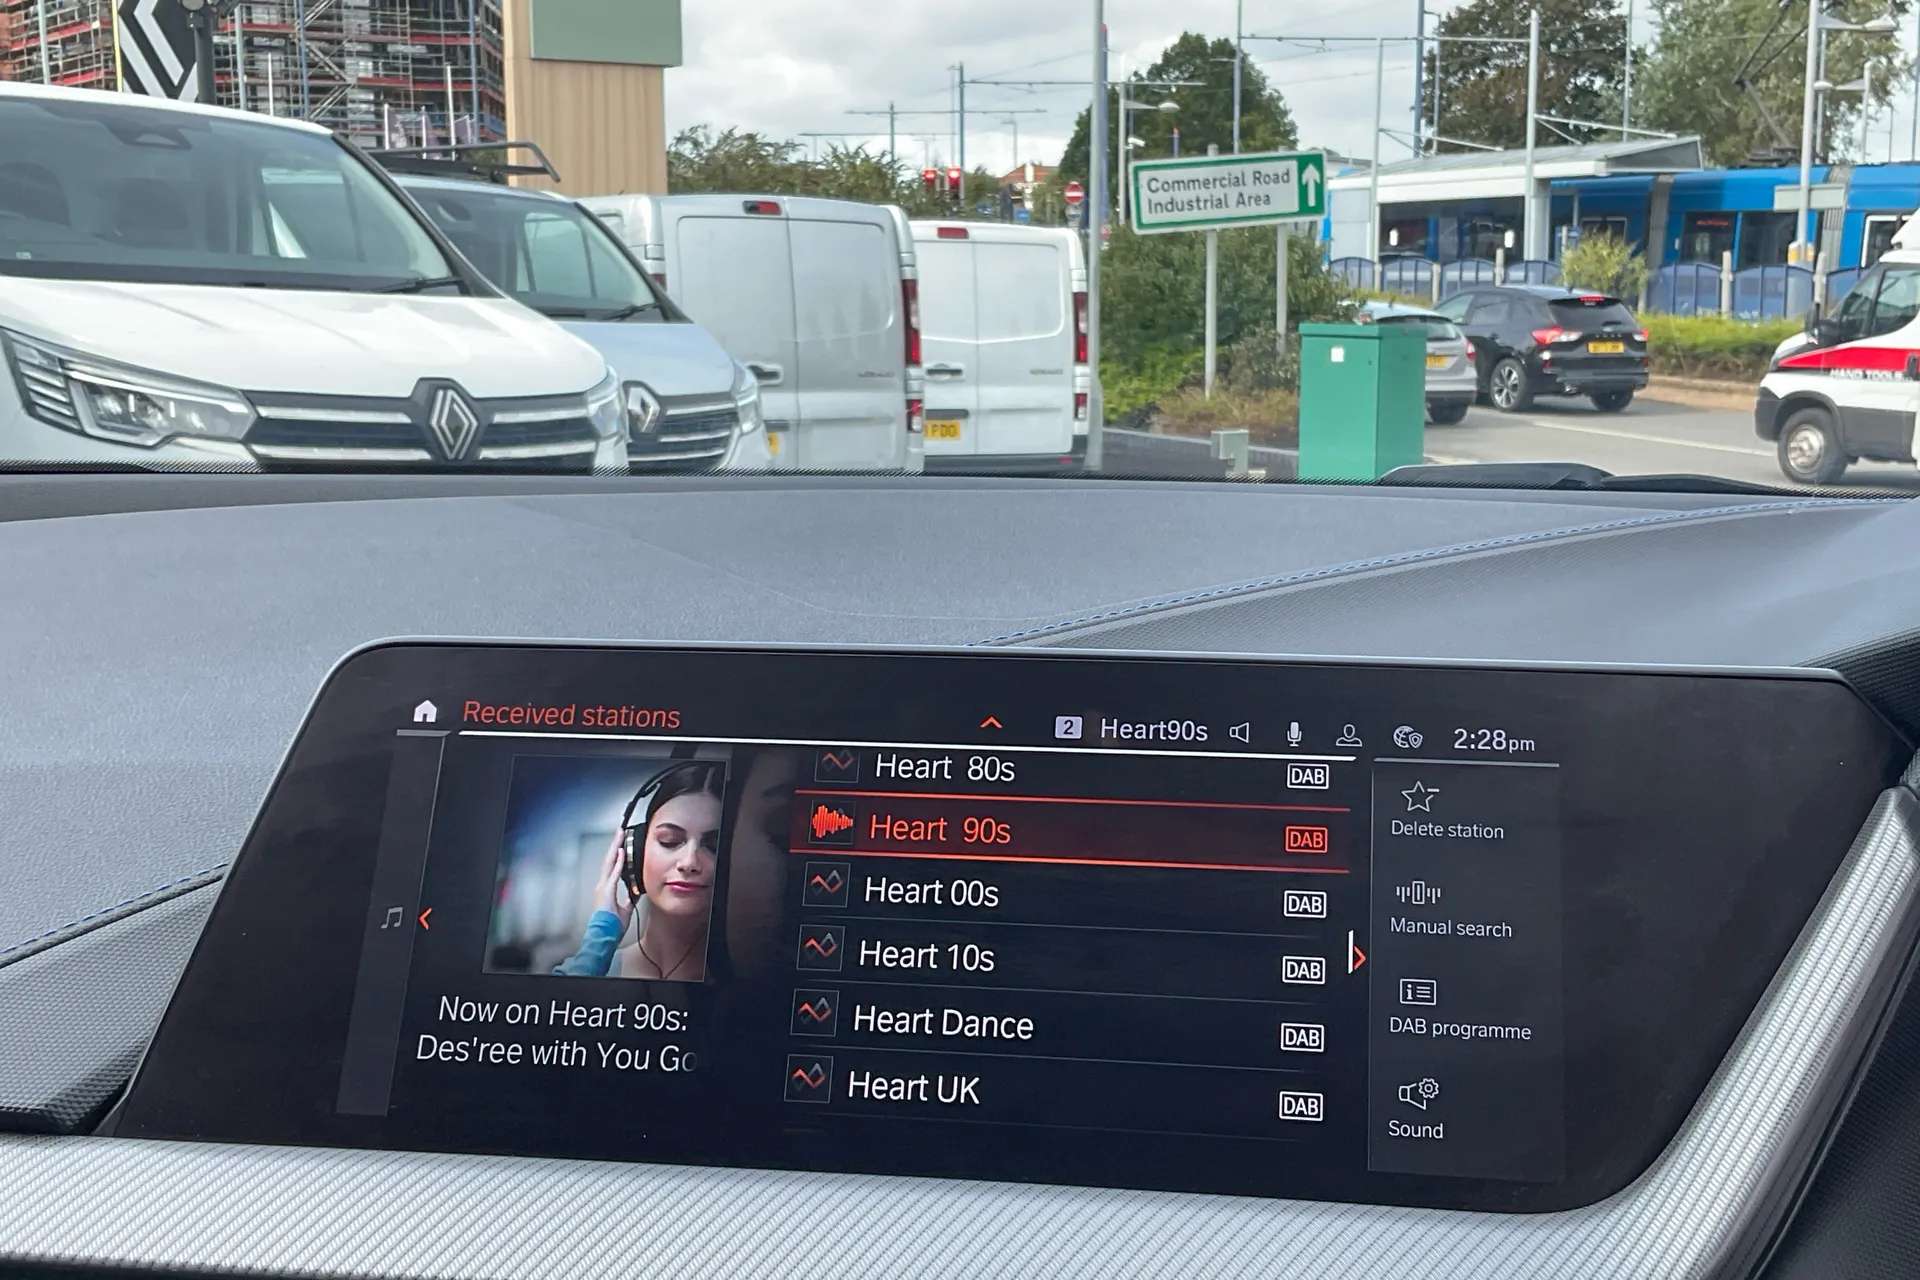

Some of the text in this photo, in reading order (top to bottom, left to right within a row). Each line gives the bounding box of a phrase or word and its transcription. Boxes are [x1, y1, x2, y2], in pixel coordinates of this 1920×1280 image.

[1146, 168, 1291, 194] Commercial Road
[1147, 192, 1272, 215] Industrial Area
[462, 700, 681, 729] Received stations
[1100, 717, 1208, 742] Heart90s
[875, 752, 1016, 782] Heart 80s
[1290, 767, 1325, 785] DAB
[870, 814, 1012, 844] Heart 90s
[1289, 831, 1324, 849] DAB
[1391, 819, 1504, 839] Delete station
[864, 876, 1000, 907] Heart 00s
[1287, 894, 1323, 913] DAB
[1390, 916, 1513, 938] Manual search
[859, 939, 996, 972] Heart 10s
[1286, 960, 1321, 979] DAB
[438, 995, 689, 1032] Now on Heart 90s:
[853, 1004, 1034, 1040] Heart Dance
[1284, 1028, 1320, 1047] DAB
[1389, 1016, 1532, 1041] DAB programme
[416, 1034, 523, 1065] Des'ree
[531, 1040, 587, 1067] with
[597, 1041, 650, 1070] You
[848, 1070, 981, 1105] Heart UK
[1282, 1096, 1319, 1116] DAB
[1388, 1119, 1444, 1139] Sound
